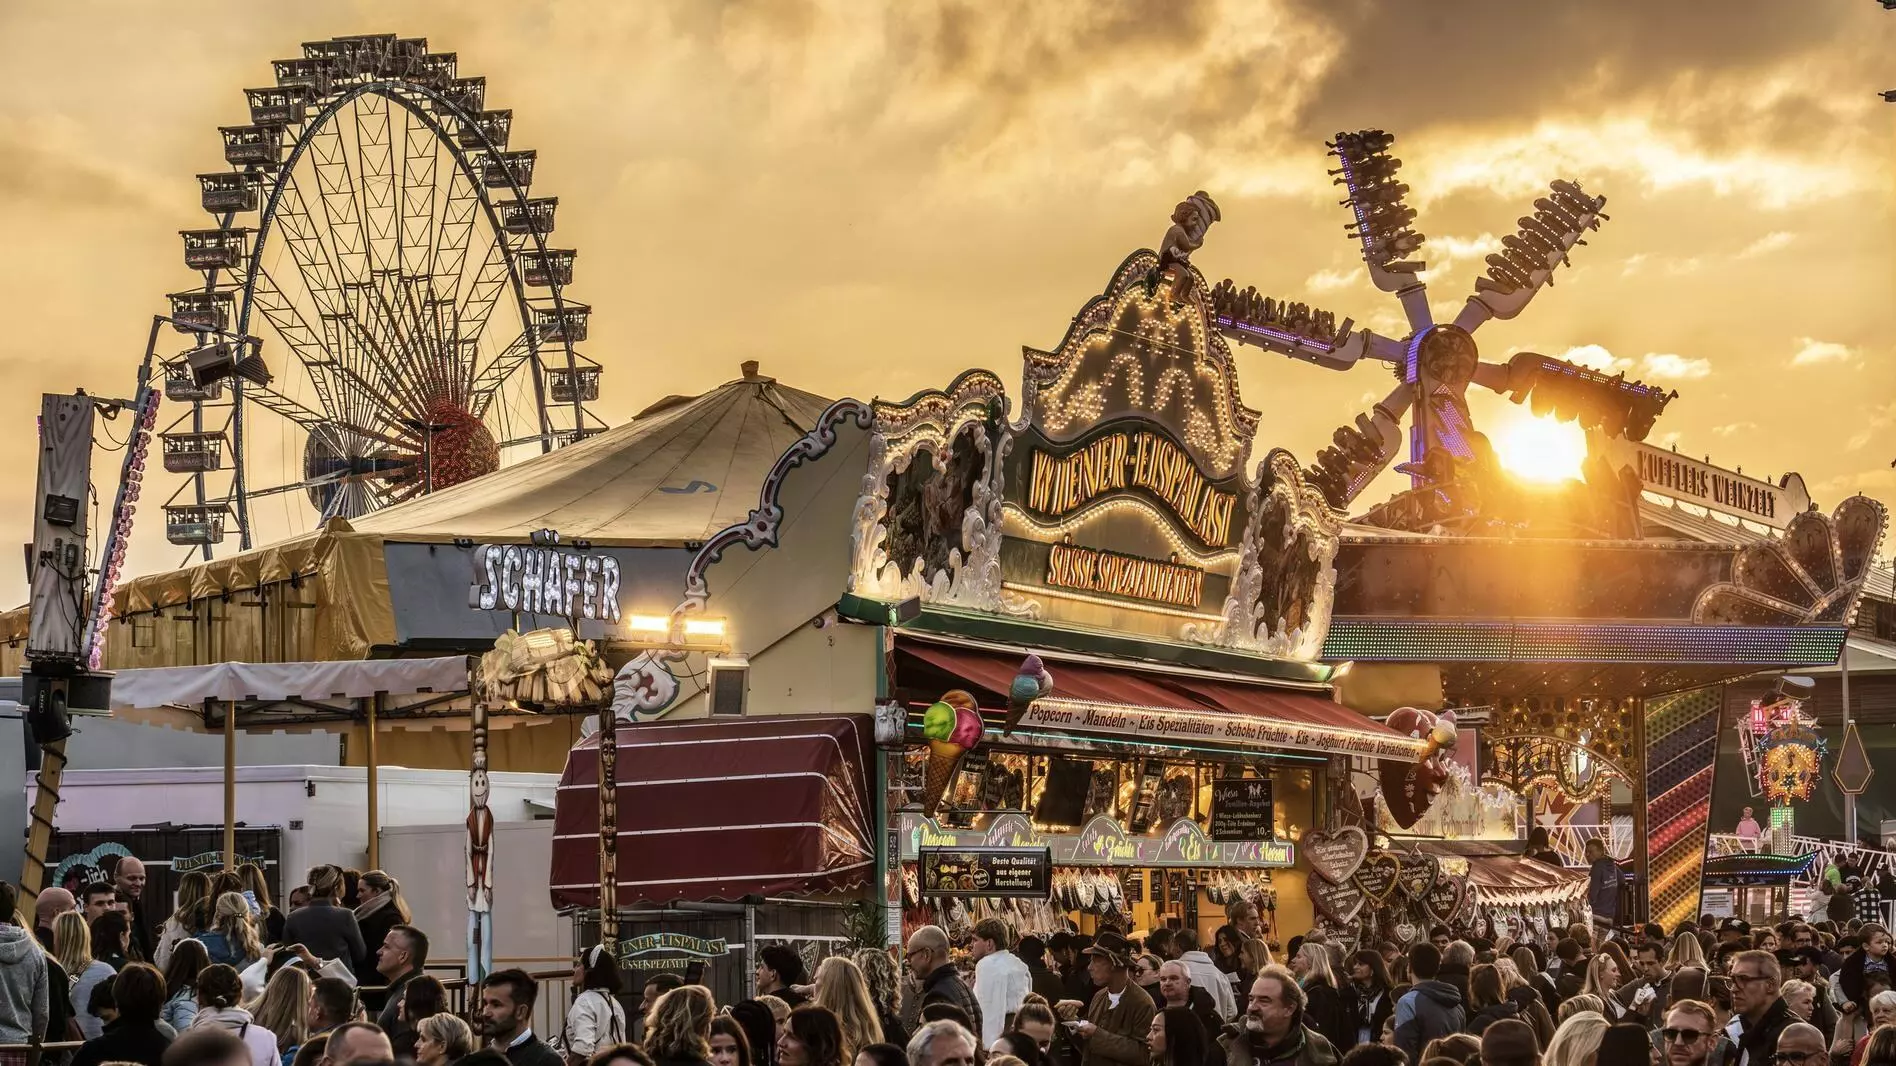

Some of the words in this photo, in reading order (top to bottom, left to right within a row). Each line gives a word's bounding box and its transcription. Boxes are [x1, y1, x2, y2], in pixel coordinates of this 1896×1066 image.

[1029, 431, 1237, 547] WIENER-EISPALAST
[1637, 450, 1708, 499] KUFFLERS
[1711, 474, 1776, 519] WEINZELT
[472, 532, 622, 626] SCHÄFER
[1029, 704, 1073, 723] Popcorn
[1083, 709, 1127, 728] Mandeln
[1138, 714, 1155, 730] Eis
[1156, 715, 1214, 735] Spezialitäten
[1225, 721, 1256, 738] Schoko
[1256, 725, 1288, 743] Früchte
[1295, 730, 1309, 745] Eis
[1316, 734, 1346, 751] Joghurt
[1347, 736, 1375, 754] Früchte
[1375, 740, 1416, 759] Variationen
[992, 856, 1009, 865] Beste
[1011, 856, 1037, 866] Qualität
[995, 879, 1033, 889] Herstellung!
[1008, 867, 1032, 877] eigener
